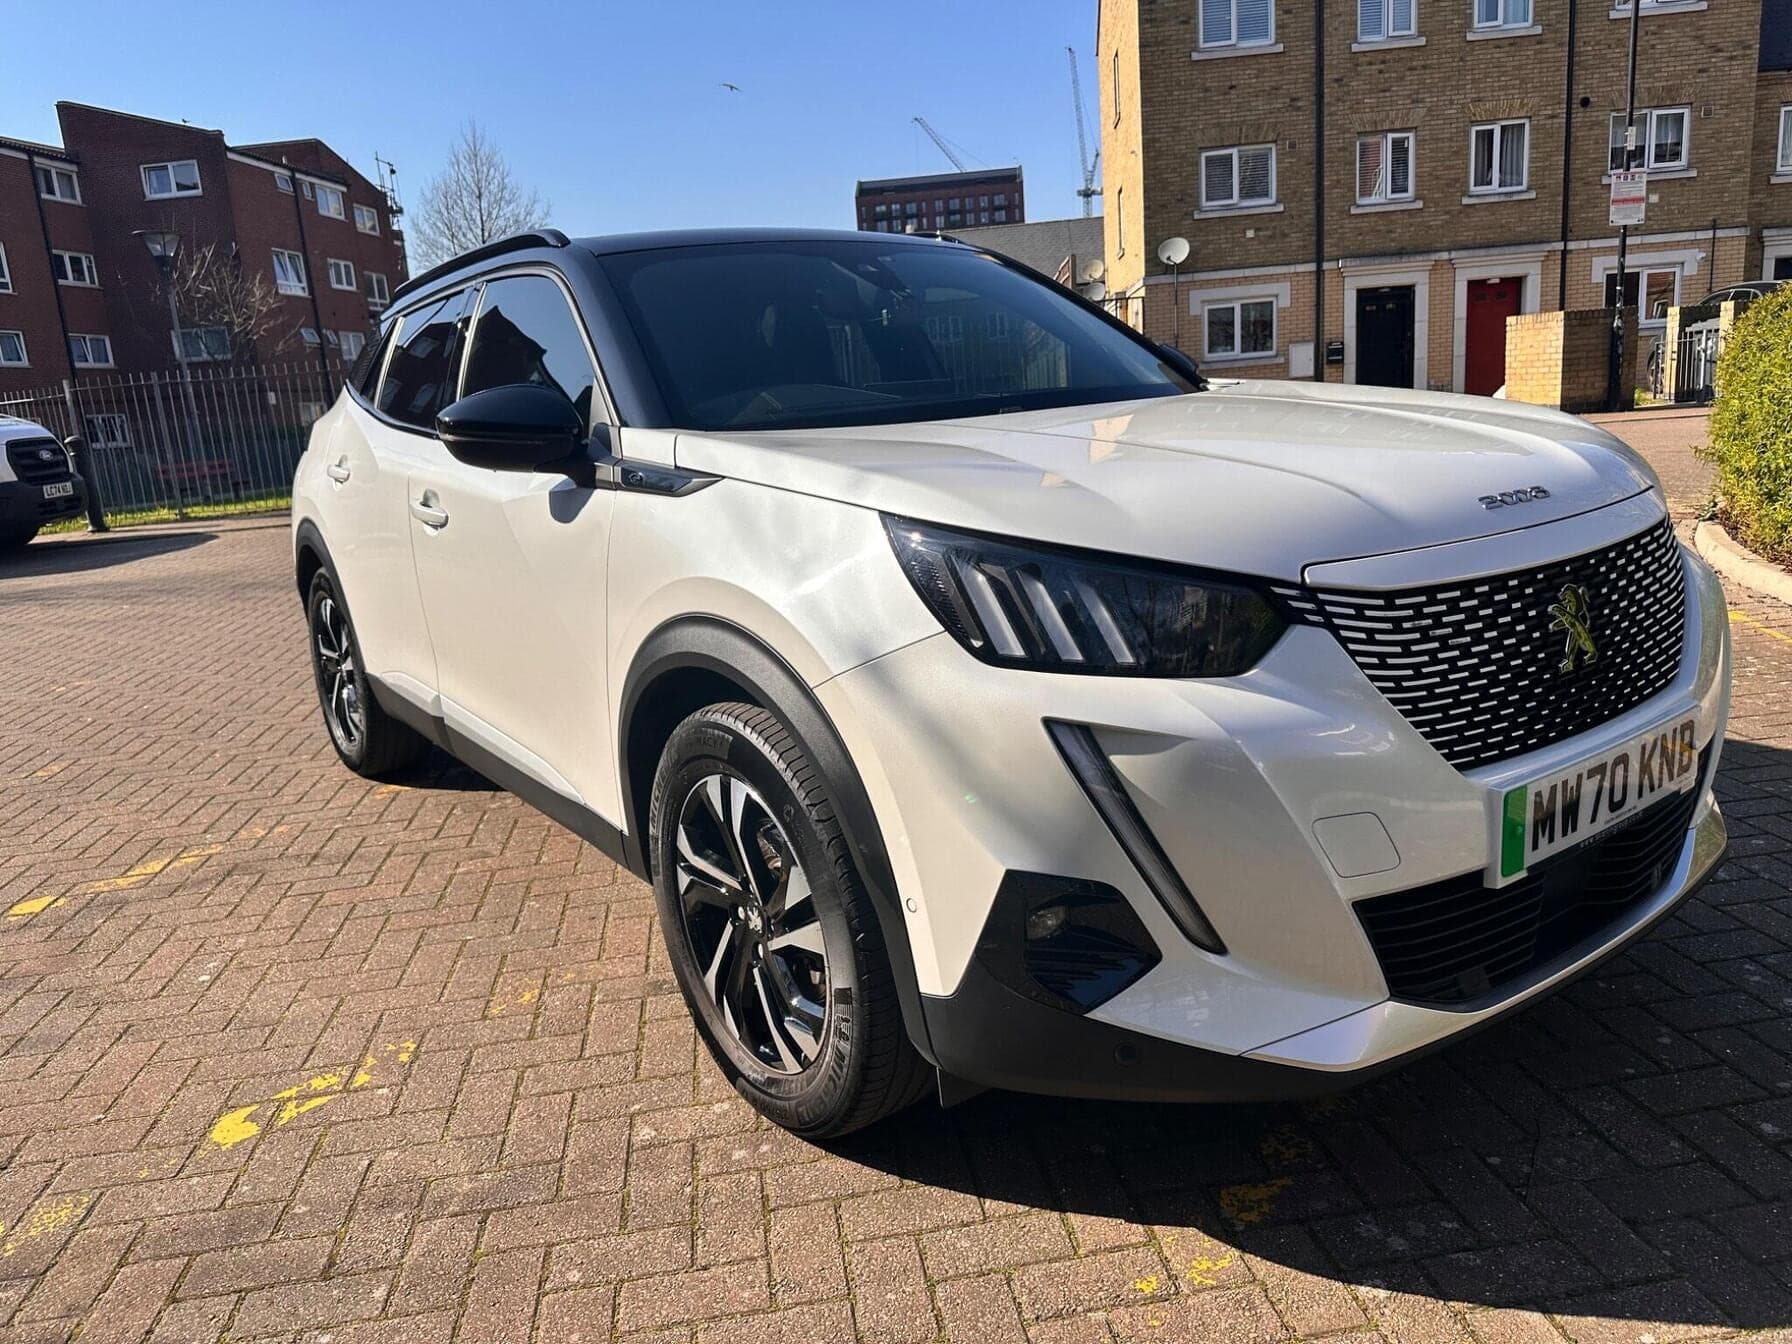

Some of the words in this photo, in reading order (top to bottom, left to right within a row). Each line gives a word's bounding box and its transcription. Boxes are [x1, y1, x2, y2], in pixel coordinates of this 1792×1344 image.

[1477, 486, 1550, 510] 2008
[1531, 752, 1630, 852] MW70
[1637, 719, 1696, 800] KNB
